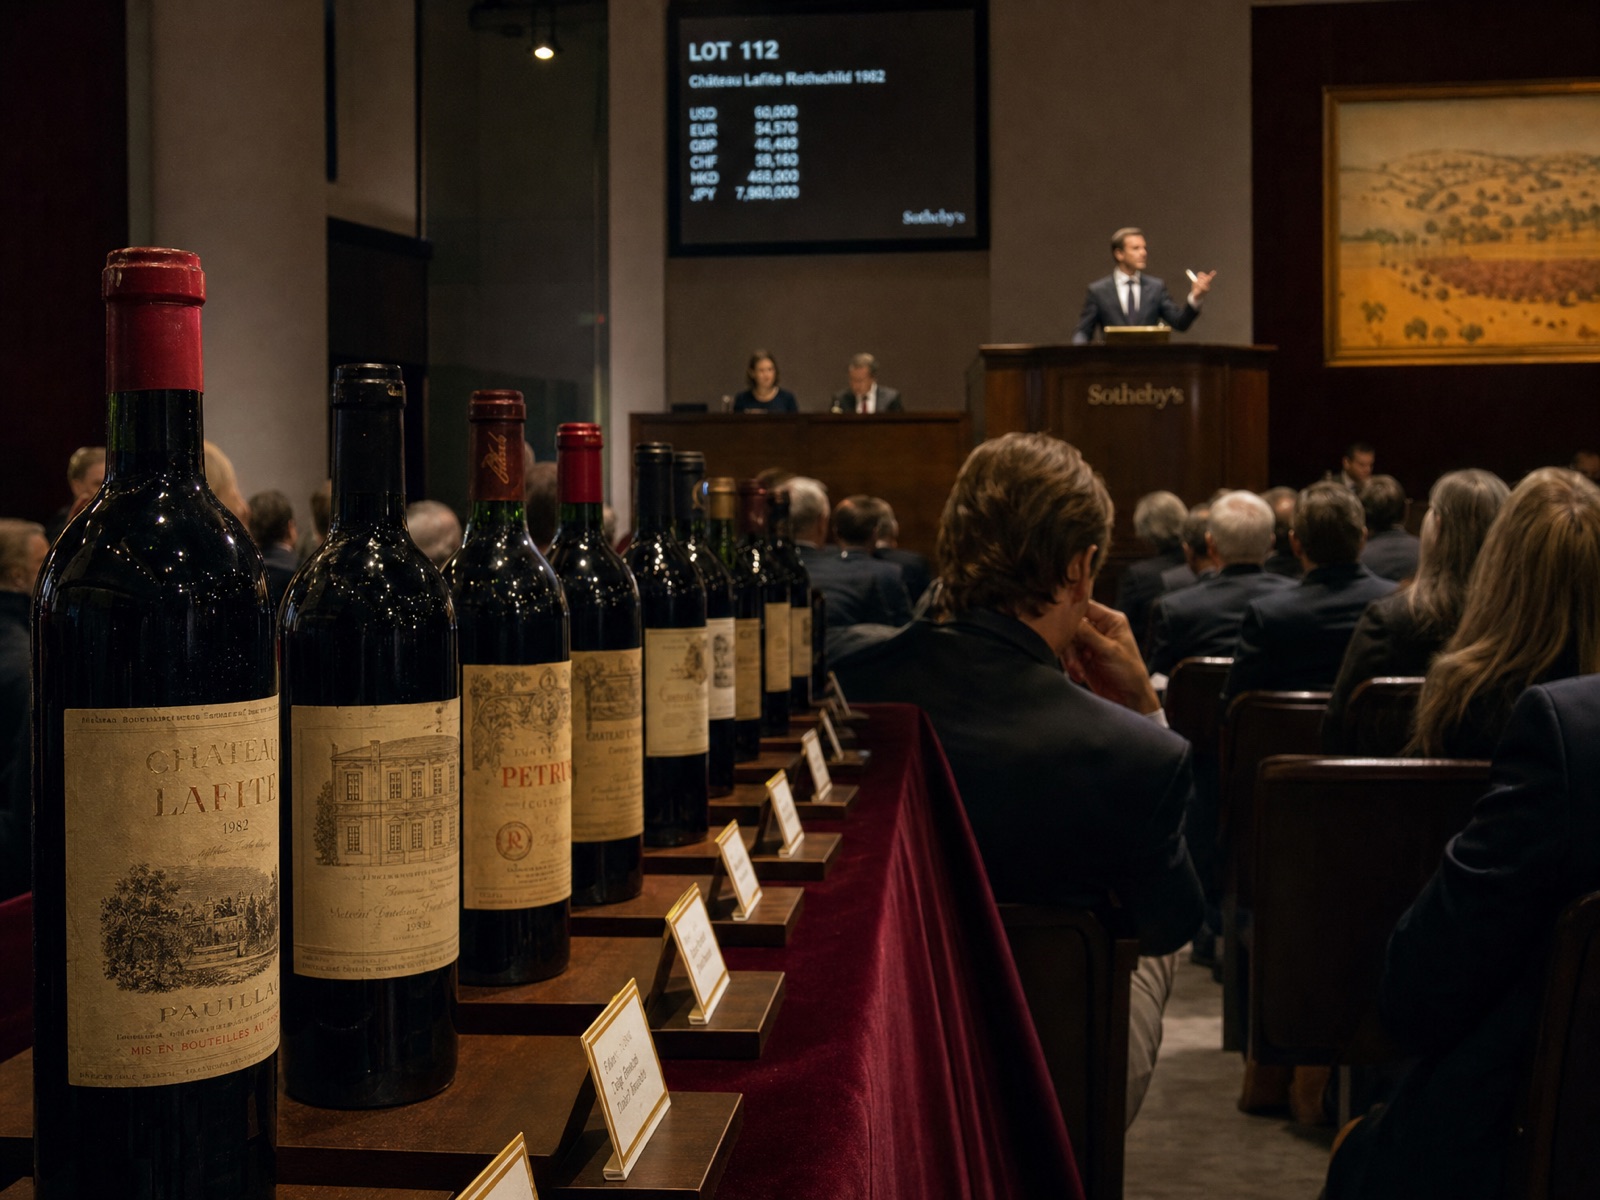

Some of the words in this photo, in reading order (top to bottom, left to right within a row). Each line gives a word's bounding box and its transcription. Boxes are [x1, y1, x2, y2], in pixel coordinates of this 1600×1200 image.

[689, 42, 731, 61] LOT
[740, 40, 778, 60] 112
[689, 73, 742, 88] Château
[744, 72, 783, 86] Lafite
[786, 70, 852, 85] Rothschild
[855, 69, 886, 83] 1982
[689, 107, 718, 121] USD
[690, 123, 718, 137] EUR
[690, 155, 718, 169] CHF
[691, 171, 720, 185] HKD
[690, 187, 716, 201] JPY
[903, 208, 966, 227] Sotheby's
[1088, 382, 1184, 409] Sotheby's
[153, 773, 276, 817] LAFITE
[223, 819, 249, 835] 1982
[131, 1046, 152, 1056] MIS
[158, 1044, 174, 1054] EN
[181, 1028, 250, 1051] BOUTEILLES
